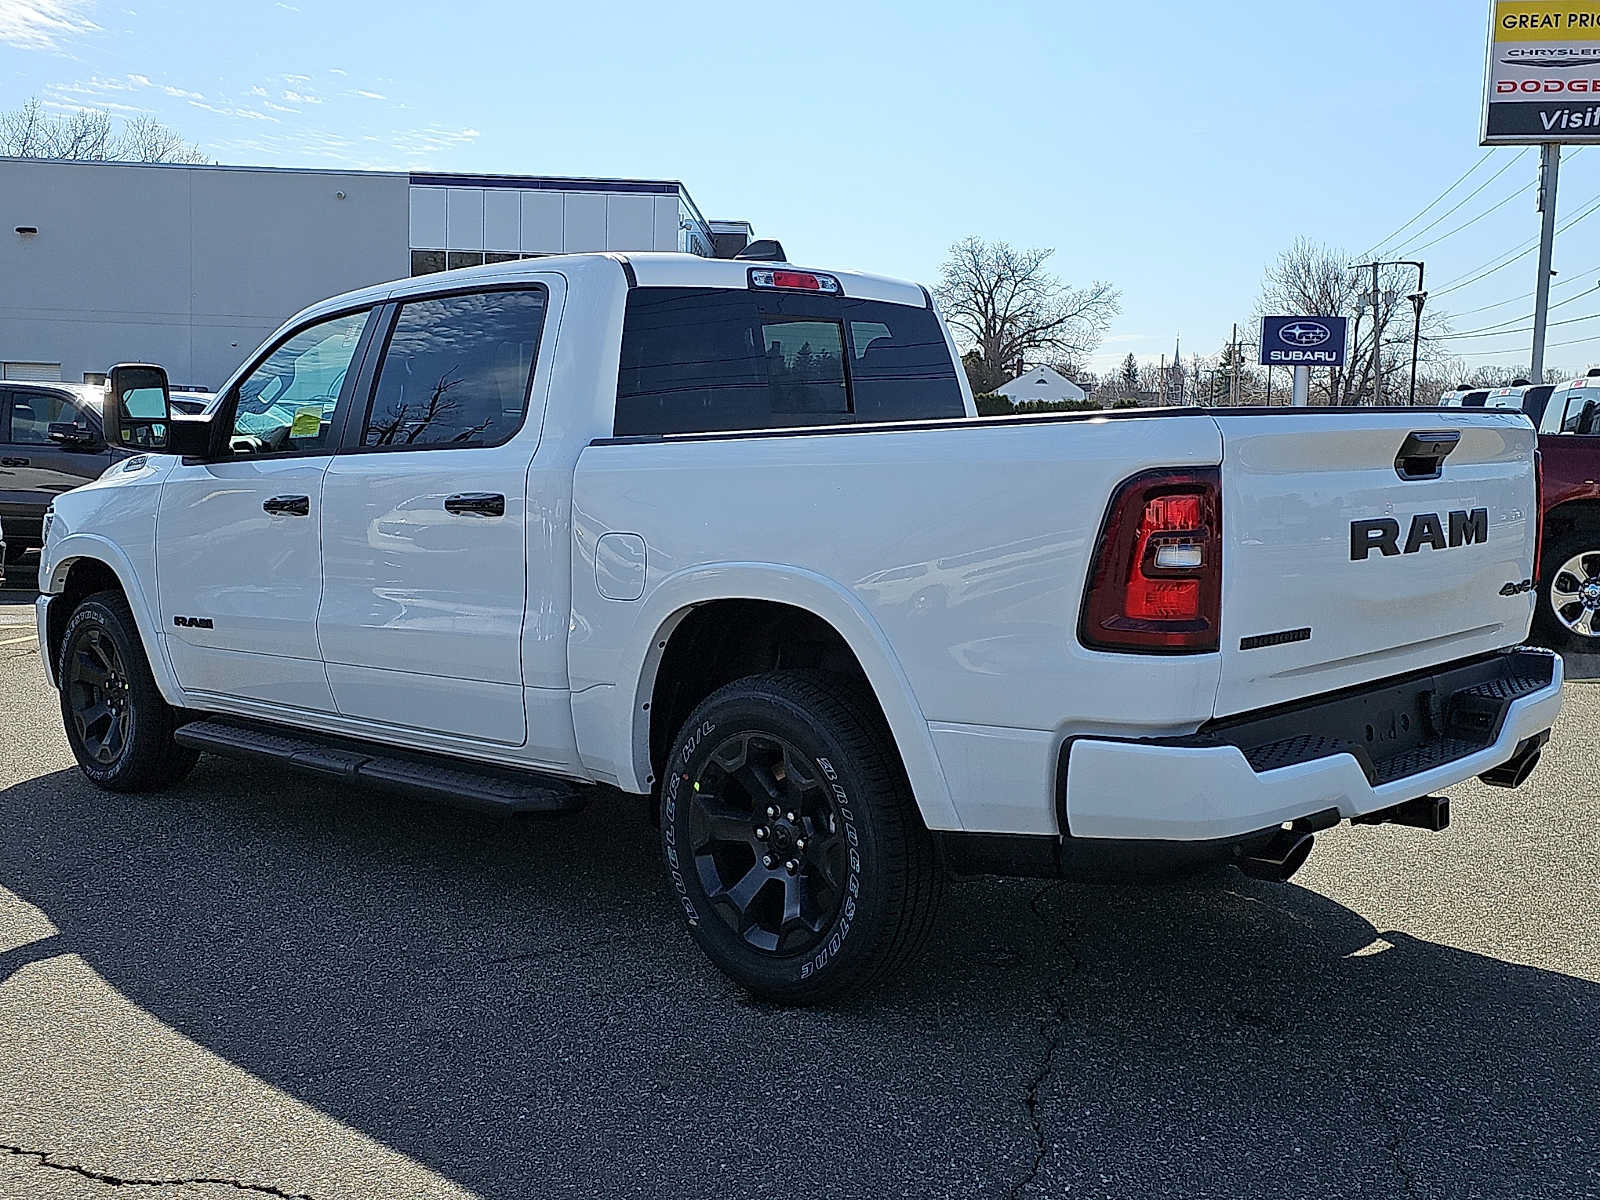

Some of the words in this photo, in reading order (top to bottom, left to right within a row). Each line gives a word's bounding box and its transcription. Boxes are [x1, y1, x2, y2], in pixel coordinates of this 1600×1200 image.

[1502, 14, 1561, 29] GREAT
[1270, 350, 1336, 362] SUBARU
[1350, 507, 1488, 561] RAM
[174, 615, 214, 629] RAM
[682, 720, 715, 763] H/L
[666, 772, 699, 926] DUELER
[800, 757, 860, 979] BRIDGESTONE
